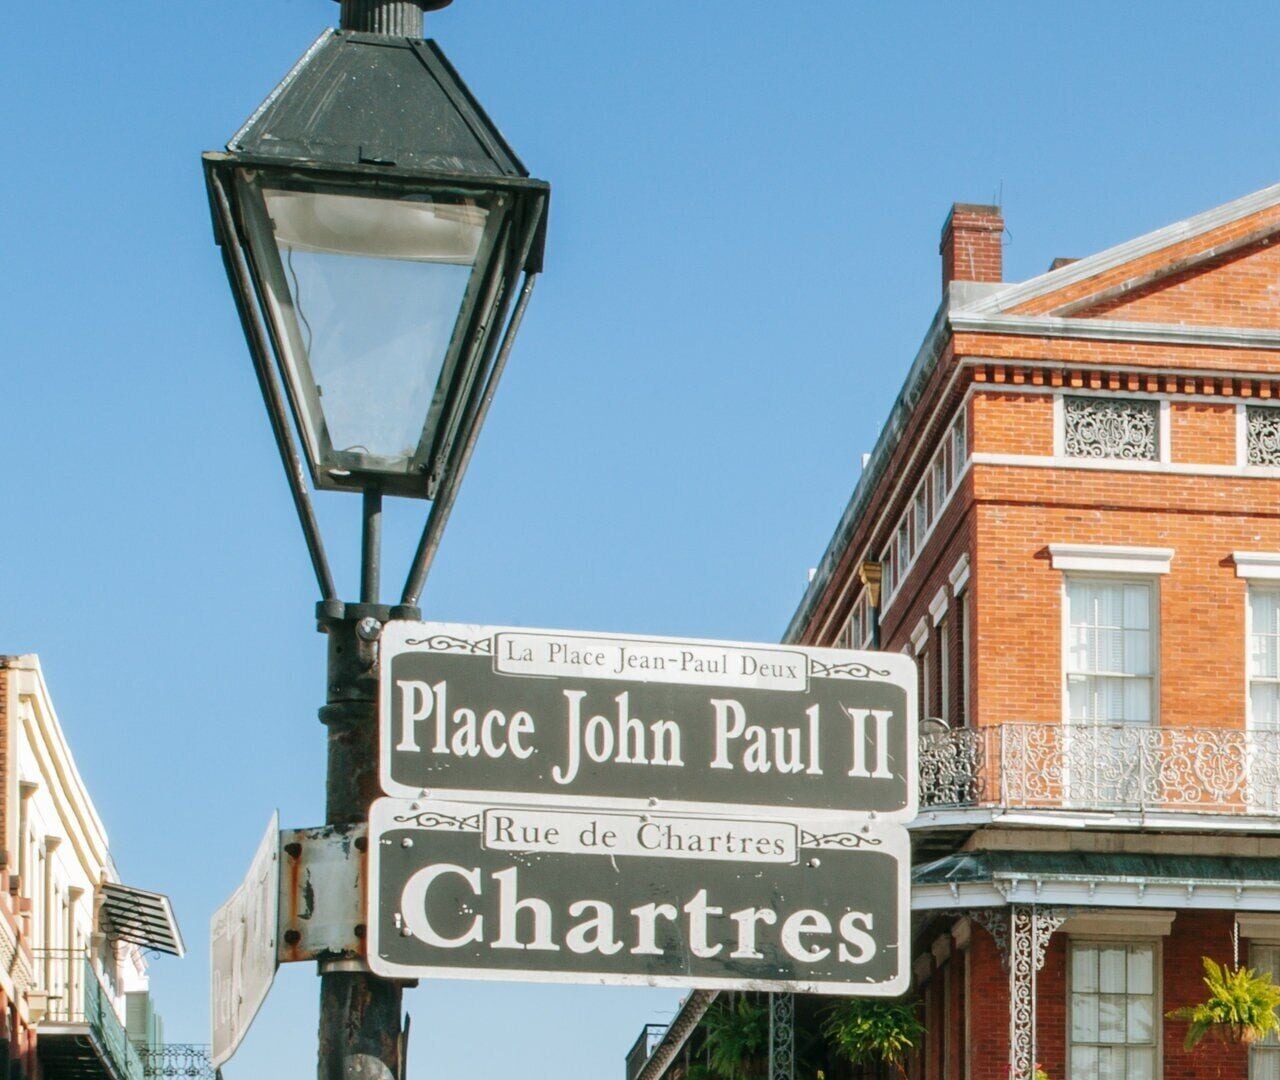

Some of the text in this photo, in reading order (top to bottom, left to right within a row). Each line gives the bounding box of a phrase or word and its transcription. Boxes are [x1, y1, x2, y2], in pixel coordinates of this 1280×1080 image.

[507, 639, 798, 680] La Place Jean-Paul Deux
[396, 680, 894, 785] Place John Paul II
[493, 815, 786, 857] Rue de Chartres
[401, 863, 877, 965] Chartres
